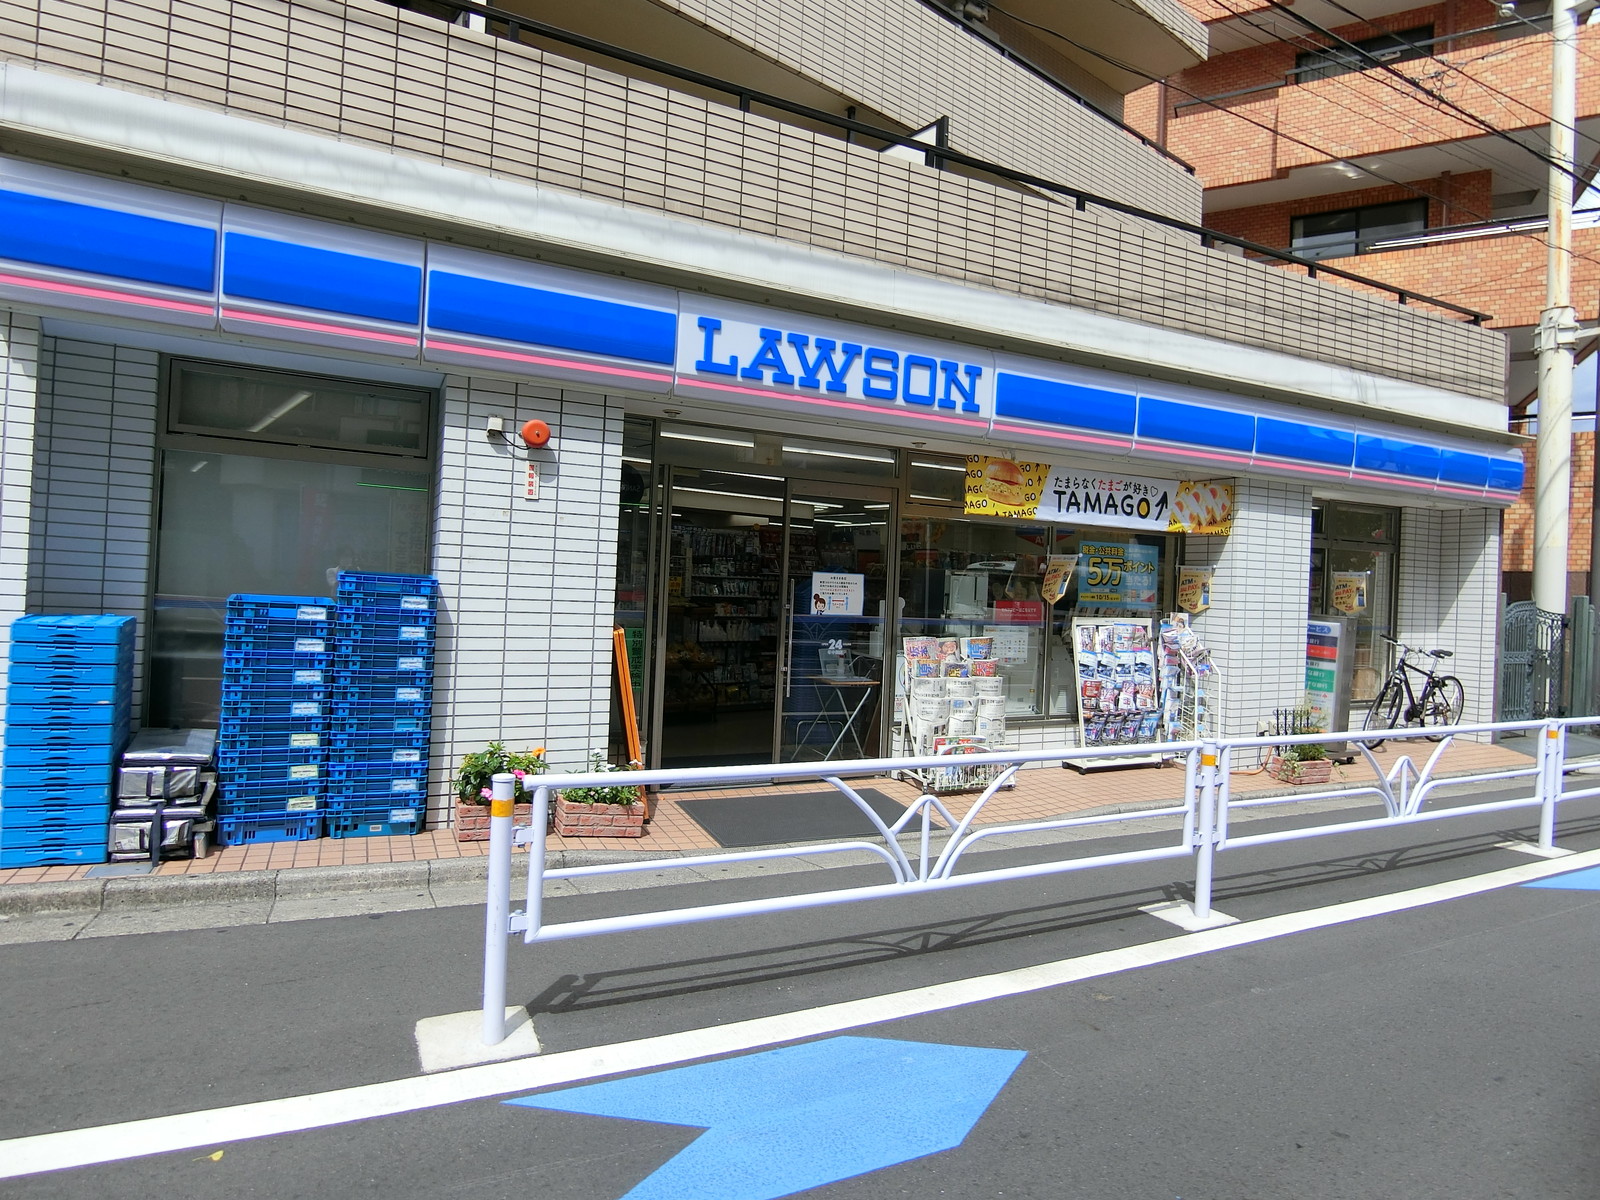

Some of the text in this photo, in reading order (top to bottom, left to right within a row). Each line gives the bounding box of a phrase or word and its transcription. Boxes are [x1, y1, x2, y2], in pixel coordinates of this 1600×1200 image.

[695, 316, 983, 413] LAWSON
[1054, 476, 1149, 497] たまらなくたまごが好き
[1053, 490, 1151, 520] TAMAGO
[1308, 625, 1330, 634] ービス
[828, 639, 843, 650] 24
